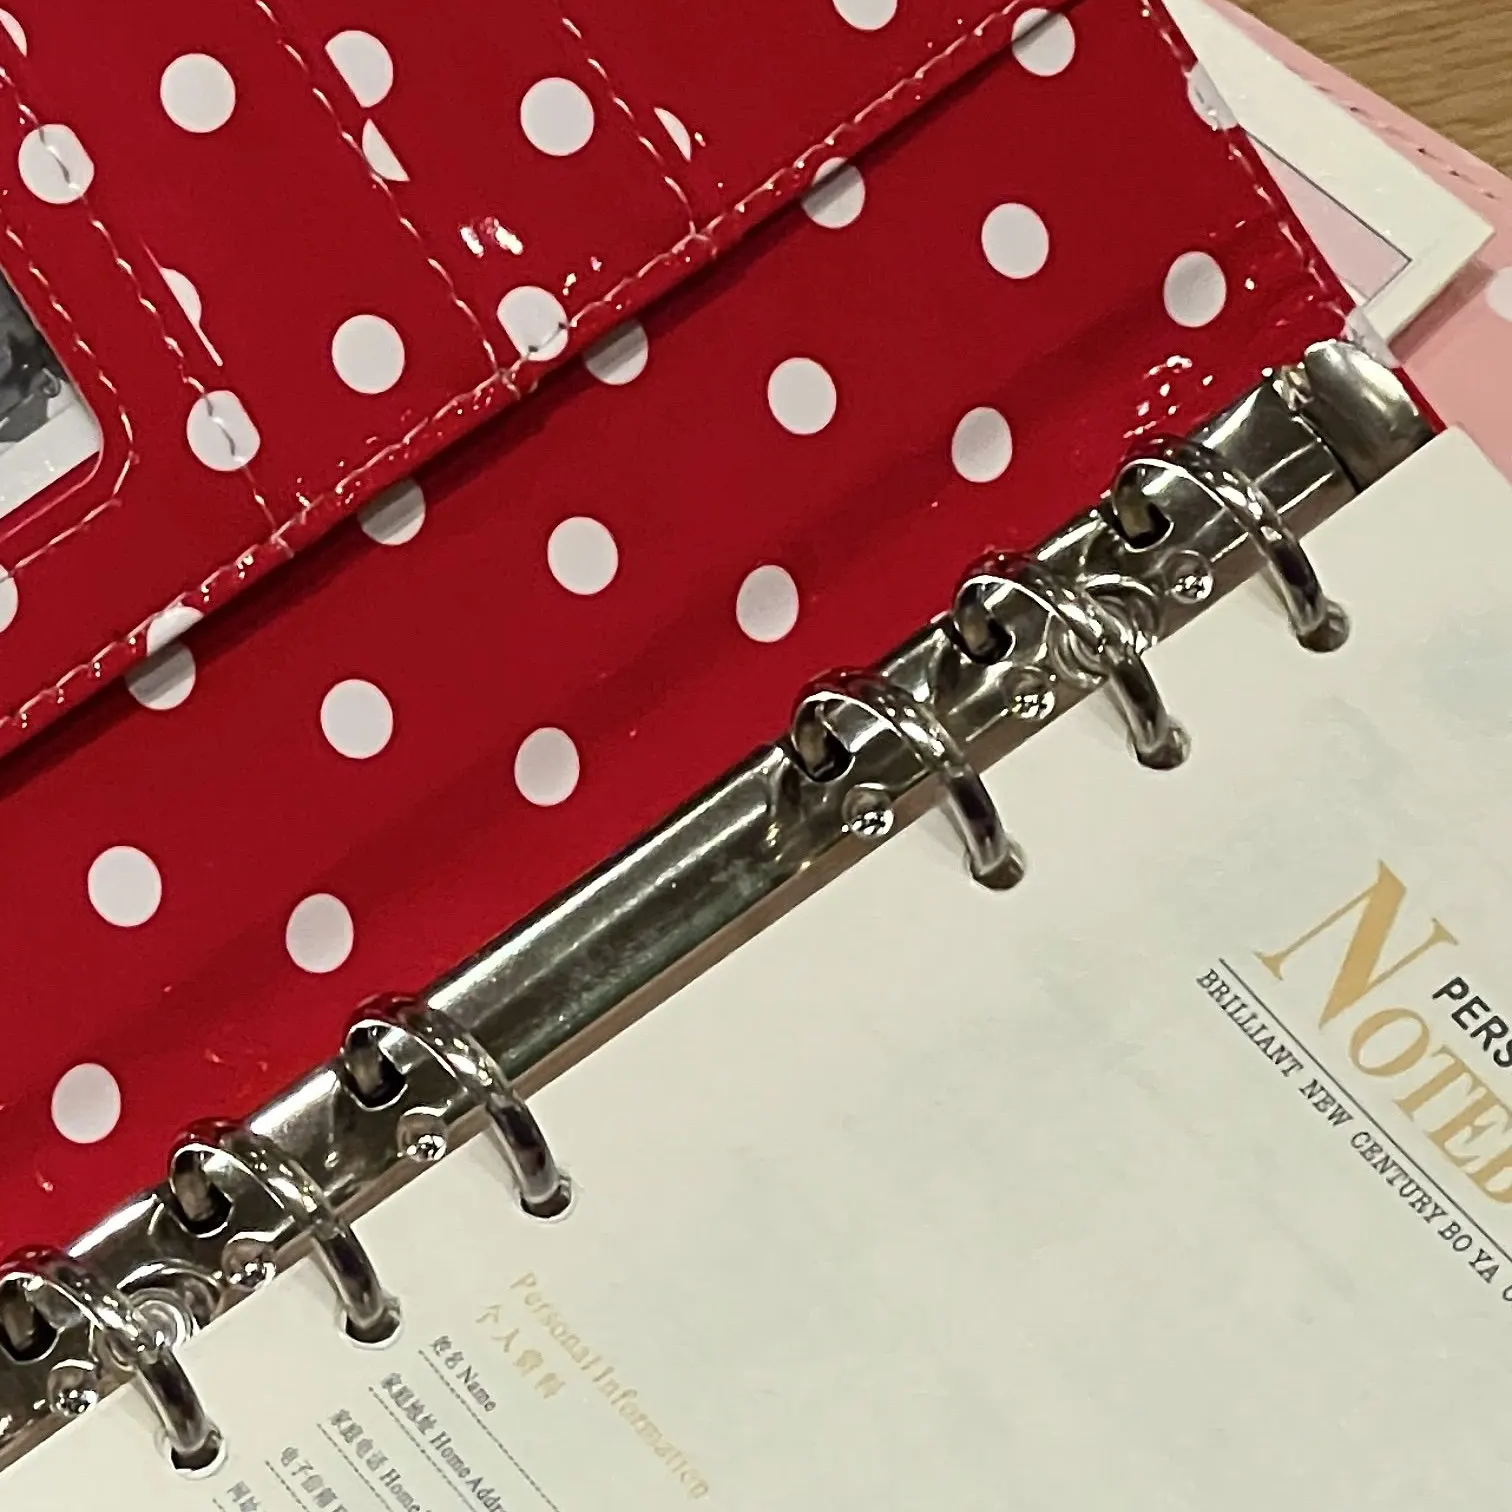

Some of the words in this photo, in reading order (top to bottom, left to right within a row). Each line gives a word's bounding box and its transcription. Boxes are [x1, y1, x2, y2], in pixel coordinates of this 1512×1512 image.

[1196, 968, 1304, 1078] BRILLIANT
[1298, 1078, 1354, 1127] NEW
[1350, 1130, 1448, 1224] CENTURY
[1437, 1220, 1473, 1252] BO
[1468, 1247, 1500, 1284] YA
[429, 1430, 471, 1478] Home
[455, 1364, 497, 1412] Name
[509, 1272, 603, 1371] Personal
[592, 1365, 710, 1500] Information
